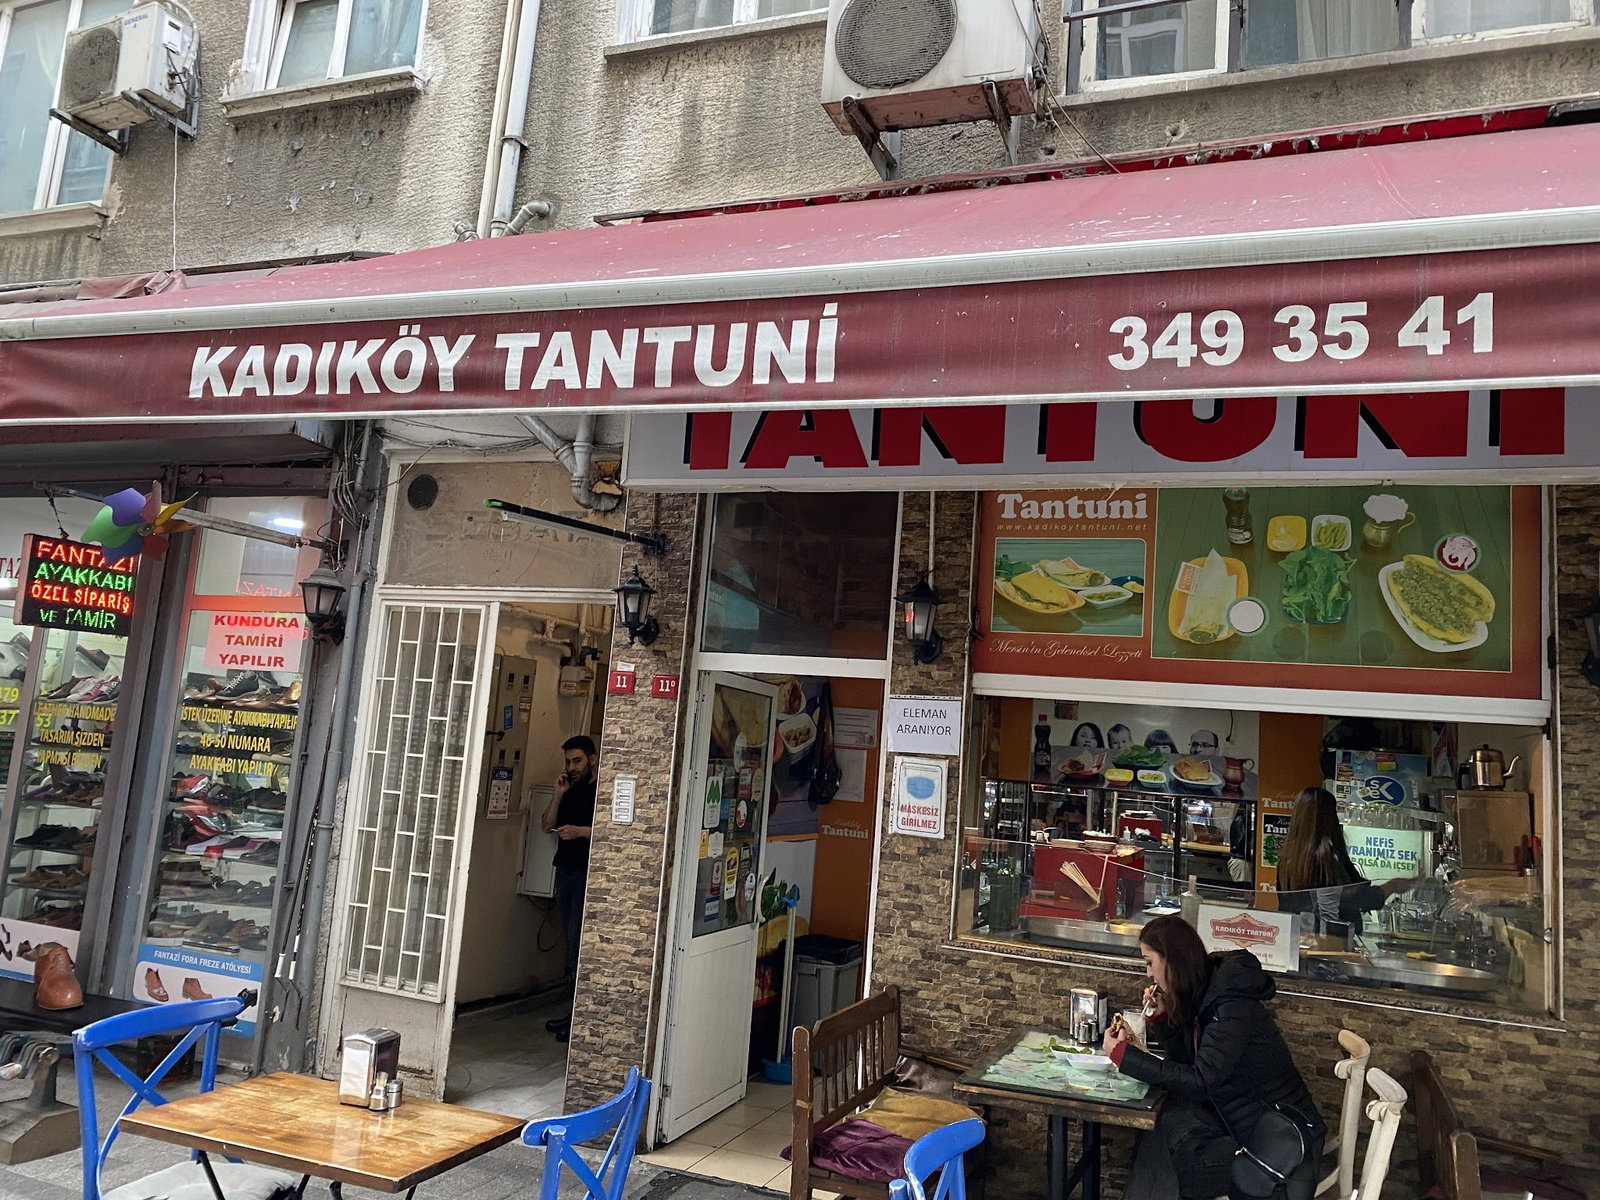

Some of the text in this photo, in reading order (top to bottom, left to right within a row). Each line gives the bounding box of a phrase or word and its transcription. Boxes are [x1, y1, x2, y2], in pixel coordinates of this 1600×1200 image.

[1107, 292, 1494, 371] 349 35 41
[188, 301, 839, 398] KADIKÖY TANTUNİ
[996, 492, 1149, 519] Tantuni
[37, 541, 134, 573] FANTZI
[33, 561, 133, 592] AYAKKABI
[31, 579, 130, 614] ÖZEL SİPARİŞ
[39, 607, 116, 630] VE TAMİR
[214, 615, 299, 628] KUNDURA
[225, 633, 283, 647] TAMİRİ
[219, 653, 284, 667] YAPILIR
[989, 638, 1143, 663] Mersin'in Geleneksel Lezzeti
[616, 675, 627, 688] 11
[0, 687, 19, 703] 79
[69, 703, 118, 722] HANDMADE
[181, 702, 204, 722] İSTEK
[202, 703, 233, 725] ÜZERİNE
[233, 710, 269, 728] AYAKKABI
[903, 707, 947, 719] ELEMAN
[40, 728, 106, 748] TASARIM SİZDEN
[896, 724, 952, 736] ARANIYOR
[200, 733, 271, 752] 46-50 NUMARA
[190, 754, 273, 777] AYAKKABI YAPILIR
[900, 803, 939, 817] MASKESİZ
[822, 824, 869, 839] Tantuni
[901, 816, 937, 830] GİRİLMEZ
[1348, 845, 1418, 861] YRANIMIZ SEK
[1380, 860, 1391, 869] DA
[1215, 925, 1246, 935] KADIKÖY
[154, 950, 252, 975] FANTAZİ FORA FREZE ATÖLYESİ
